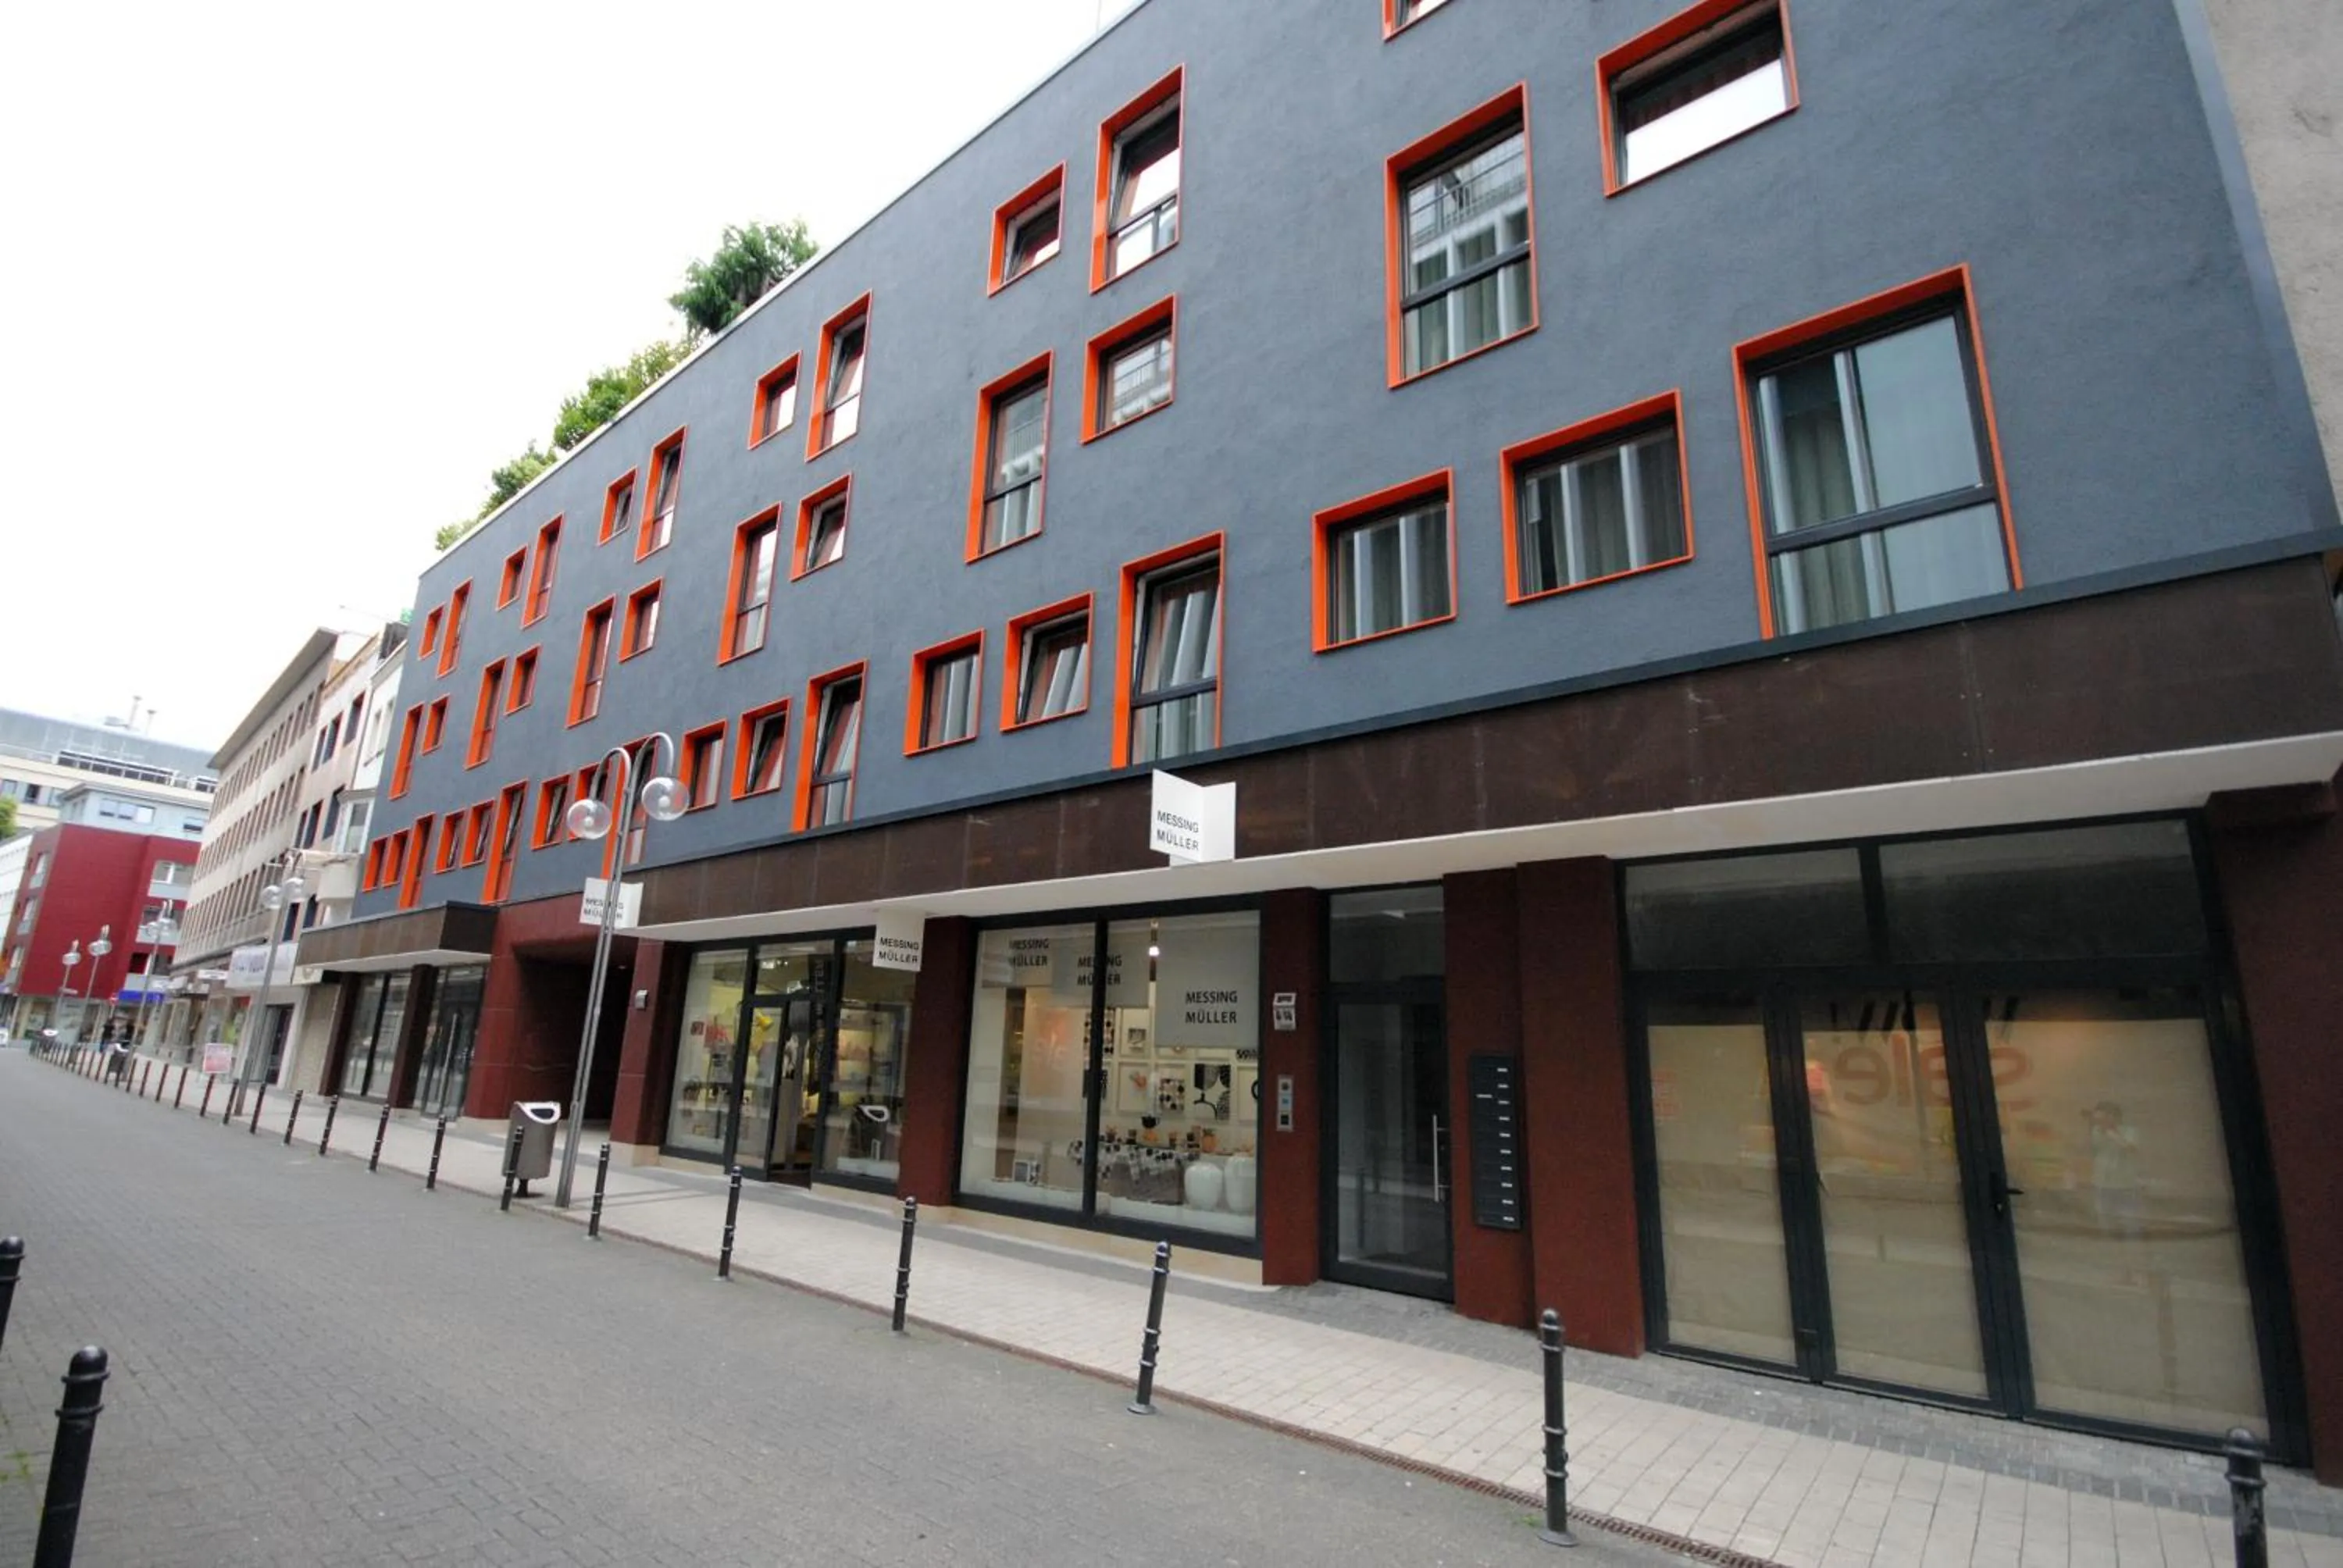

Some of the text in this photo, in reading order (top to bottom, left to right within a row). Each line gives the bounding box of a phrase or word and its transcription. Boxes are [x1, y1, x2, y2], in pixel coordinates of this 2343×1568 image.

[1157, 811, 1199, 833] MESSING
[1157, 829, 1199, 850] MÜLLER
[880, 937, 919, 950] MESSING
[879, 950, 918, 963] MÜLLER
[1186, 990, 1238, 1003] MESSING
[1186, 1009, 1238, 1024] MÜLLER
